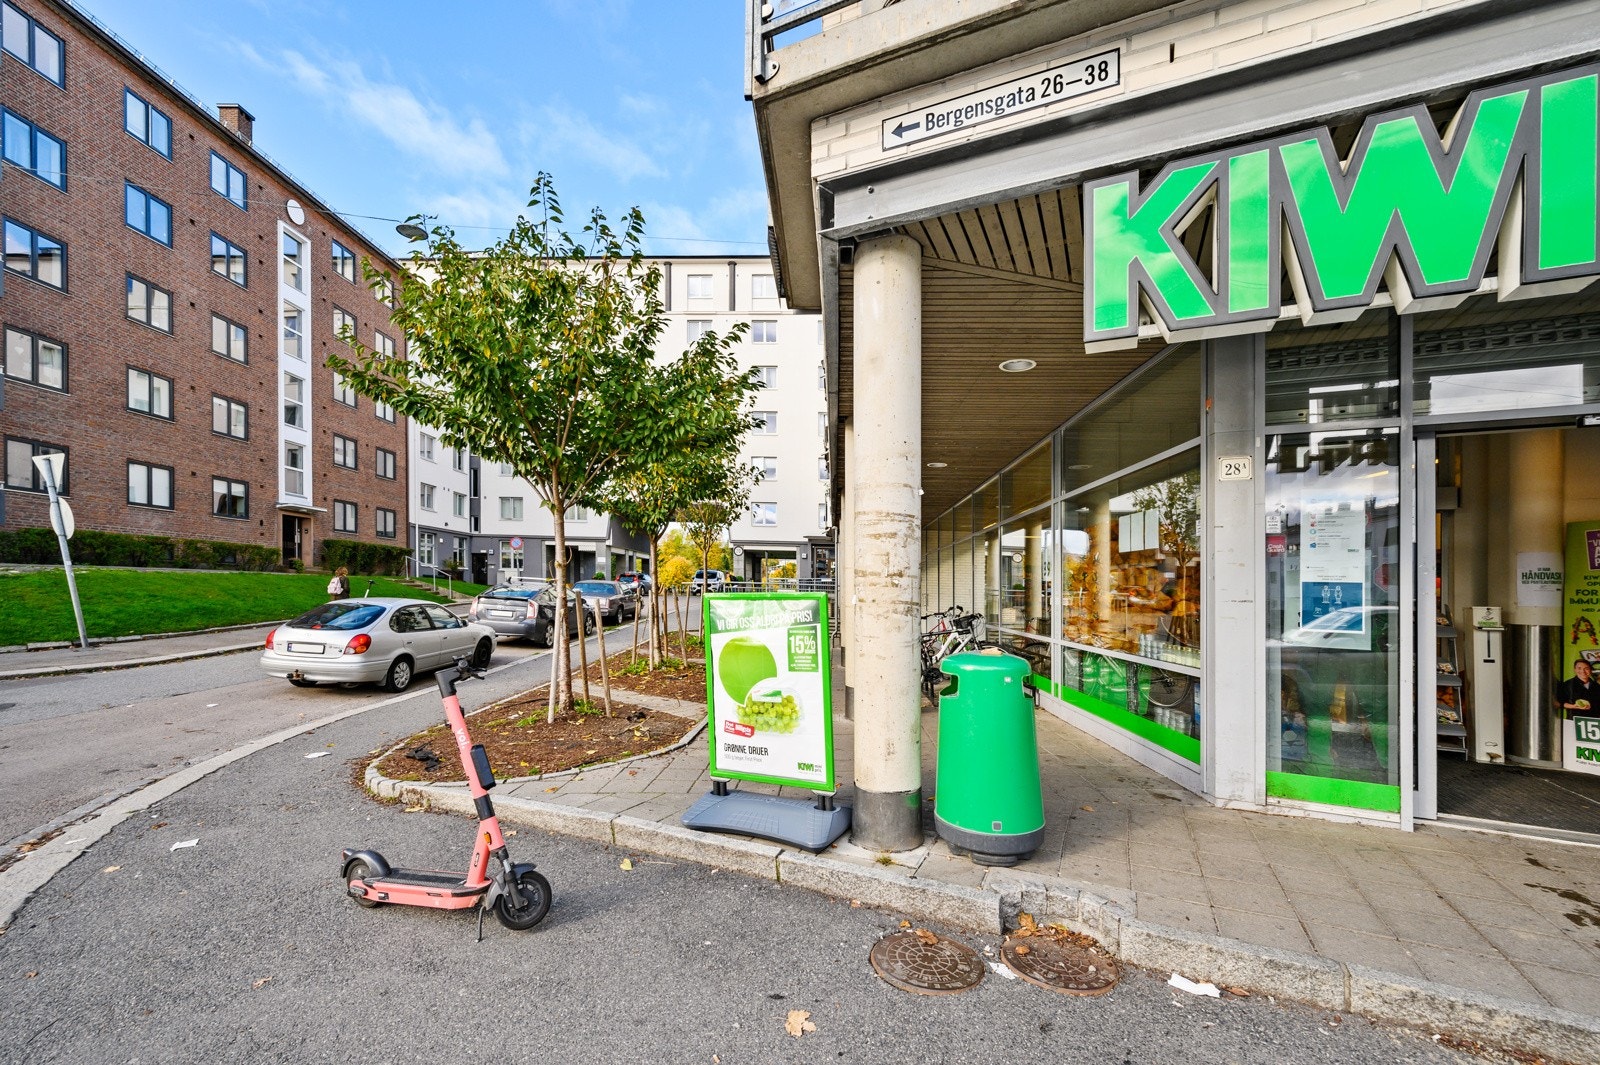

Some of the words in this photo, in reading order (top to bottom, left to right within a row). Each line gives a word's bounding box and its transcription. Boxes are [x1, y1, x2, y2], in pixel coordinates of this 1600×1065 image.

[925, 86, 1036, 132] Bergensgata
[1084, 62, 1600, 346] KIWI
[717, 619, 725, 631] VI
[739, 616, 754, 629] OSS
[790, 609, 813, 624] PRIS!
[789, 635, 816, 654] 15%
[723, 742, 748, 754] GRØNNE
[748, 745, 769, 757] DRUER
[797, 762, 815, 772] KIWI
